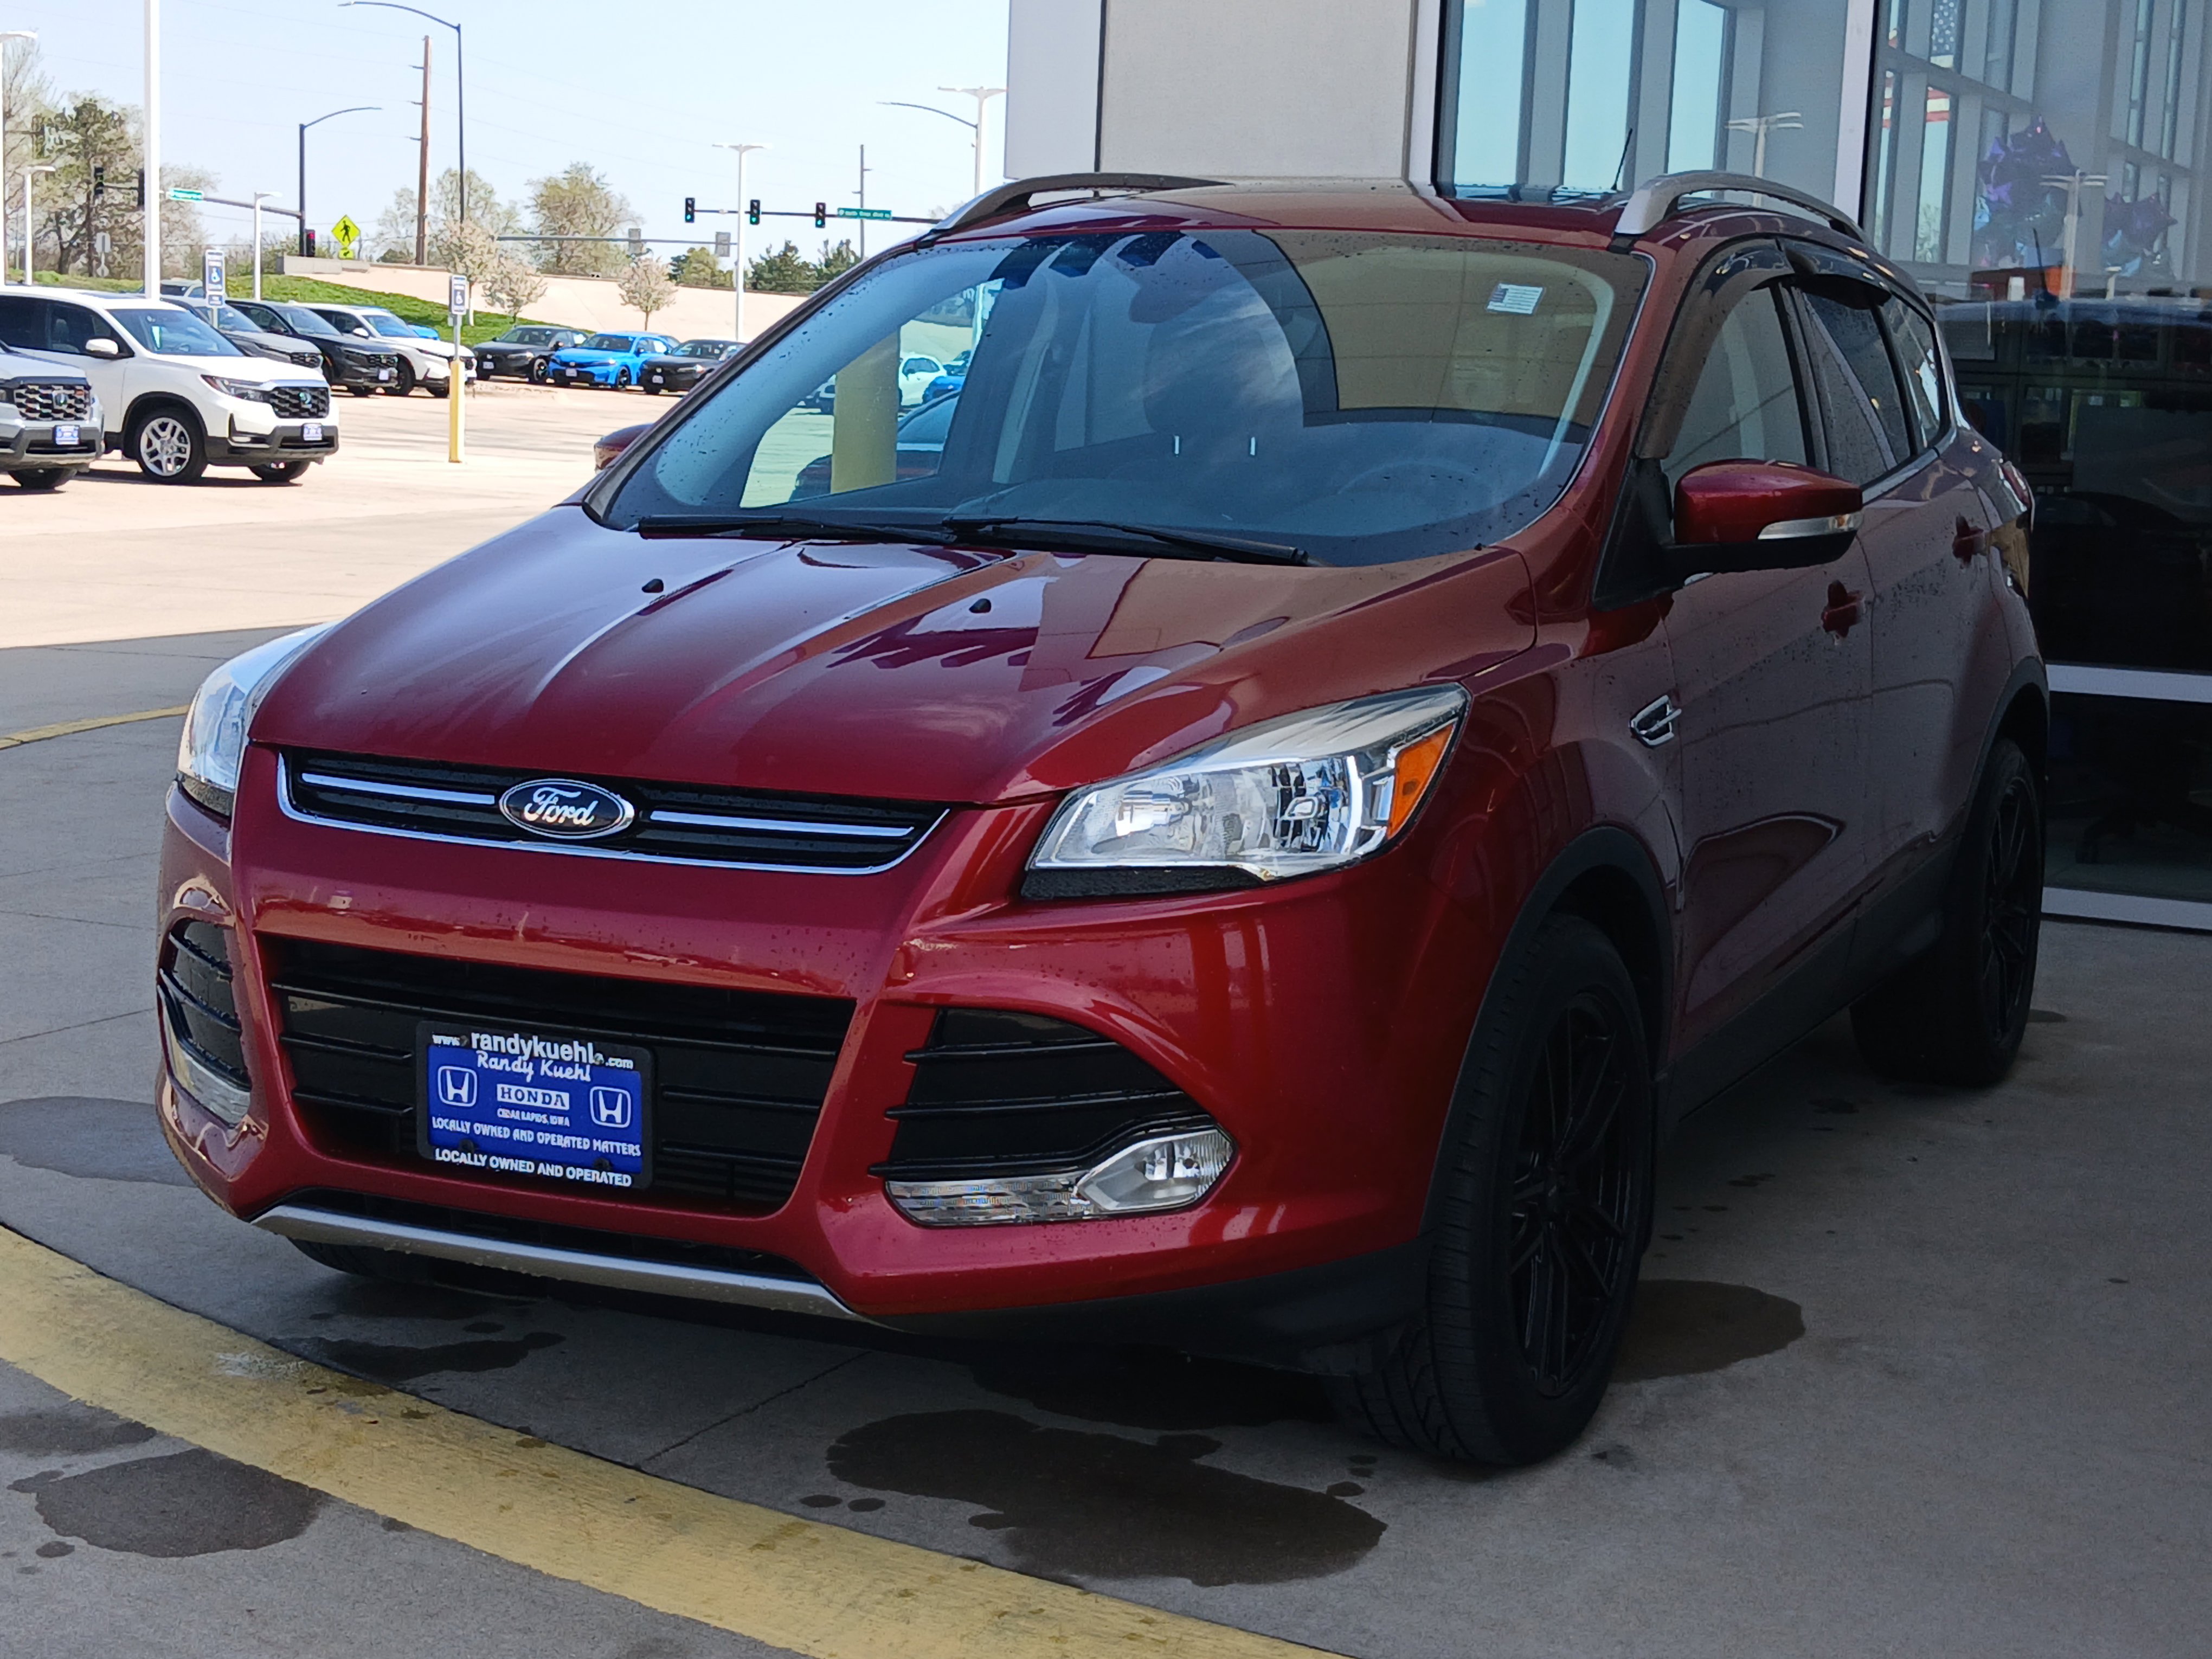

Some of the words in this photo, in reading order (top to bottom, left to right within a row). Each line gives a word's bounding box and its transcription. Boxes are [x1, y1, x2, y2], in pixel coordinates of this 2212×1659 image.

[524, 787, 598, 825] Ford
[476, 1050, 534, 1082] Randy
[540, 1059, 591, 1082] Kuehl
[500, 1086, 566, 1107] HONDA
[432, 1117, 471, 1134] LOCALLY
[473, 1123, 511, 1139] OWNED
[513, 1128, 534, 1142] AND
[537, 1131, 590, 1150] OPERATED
[593, 1139, 641, 1156] MATTERS
[435, 1148, 487, 1167] LOCALLY
[490, 1156, 535, 1173] OWNED
[537, 1162, 563, 1177] AND
[565, 1166, 632, 1187] OPERATED
